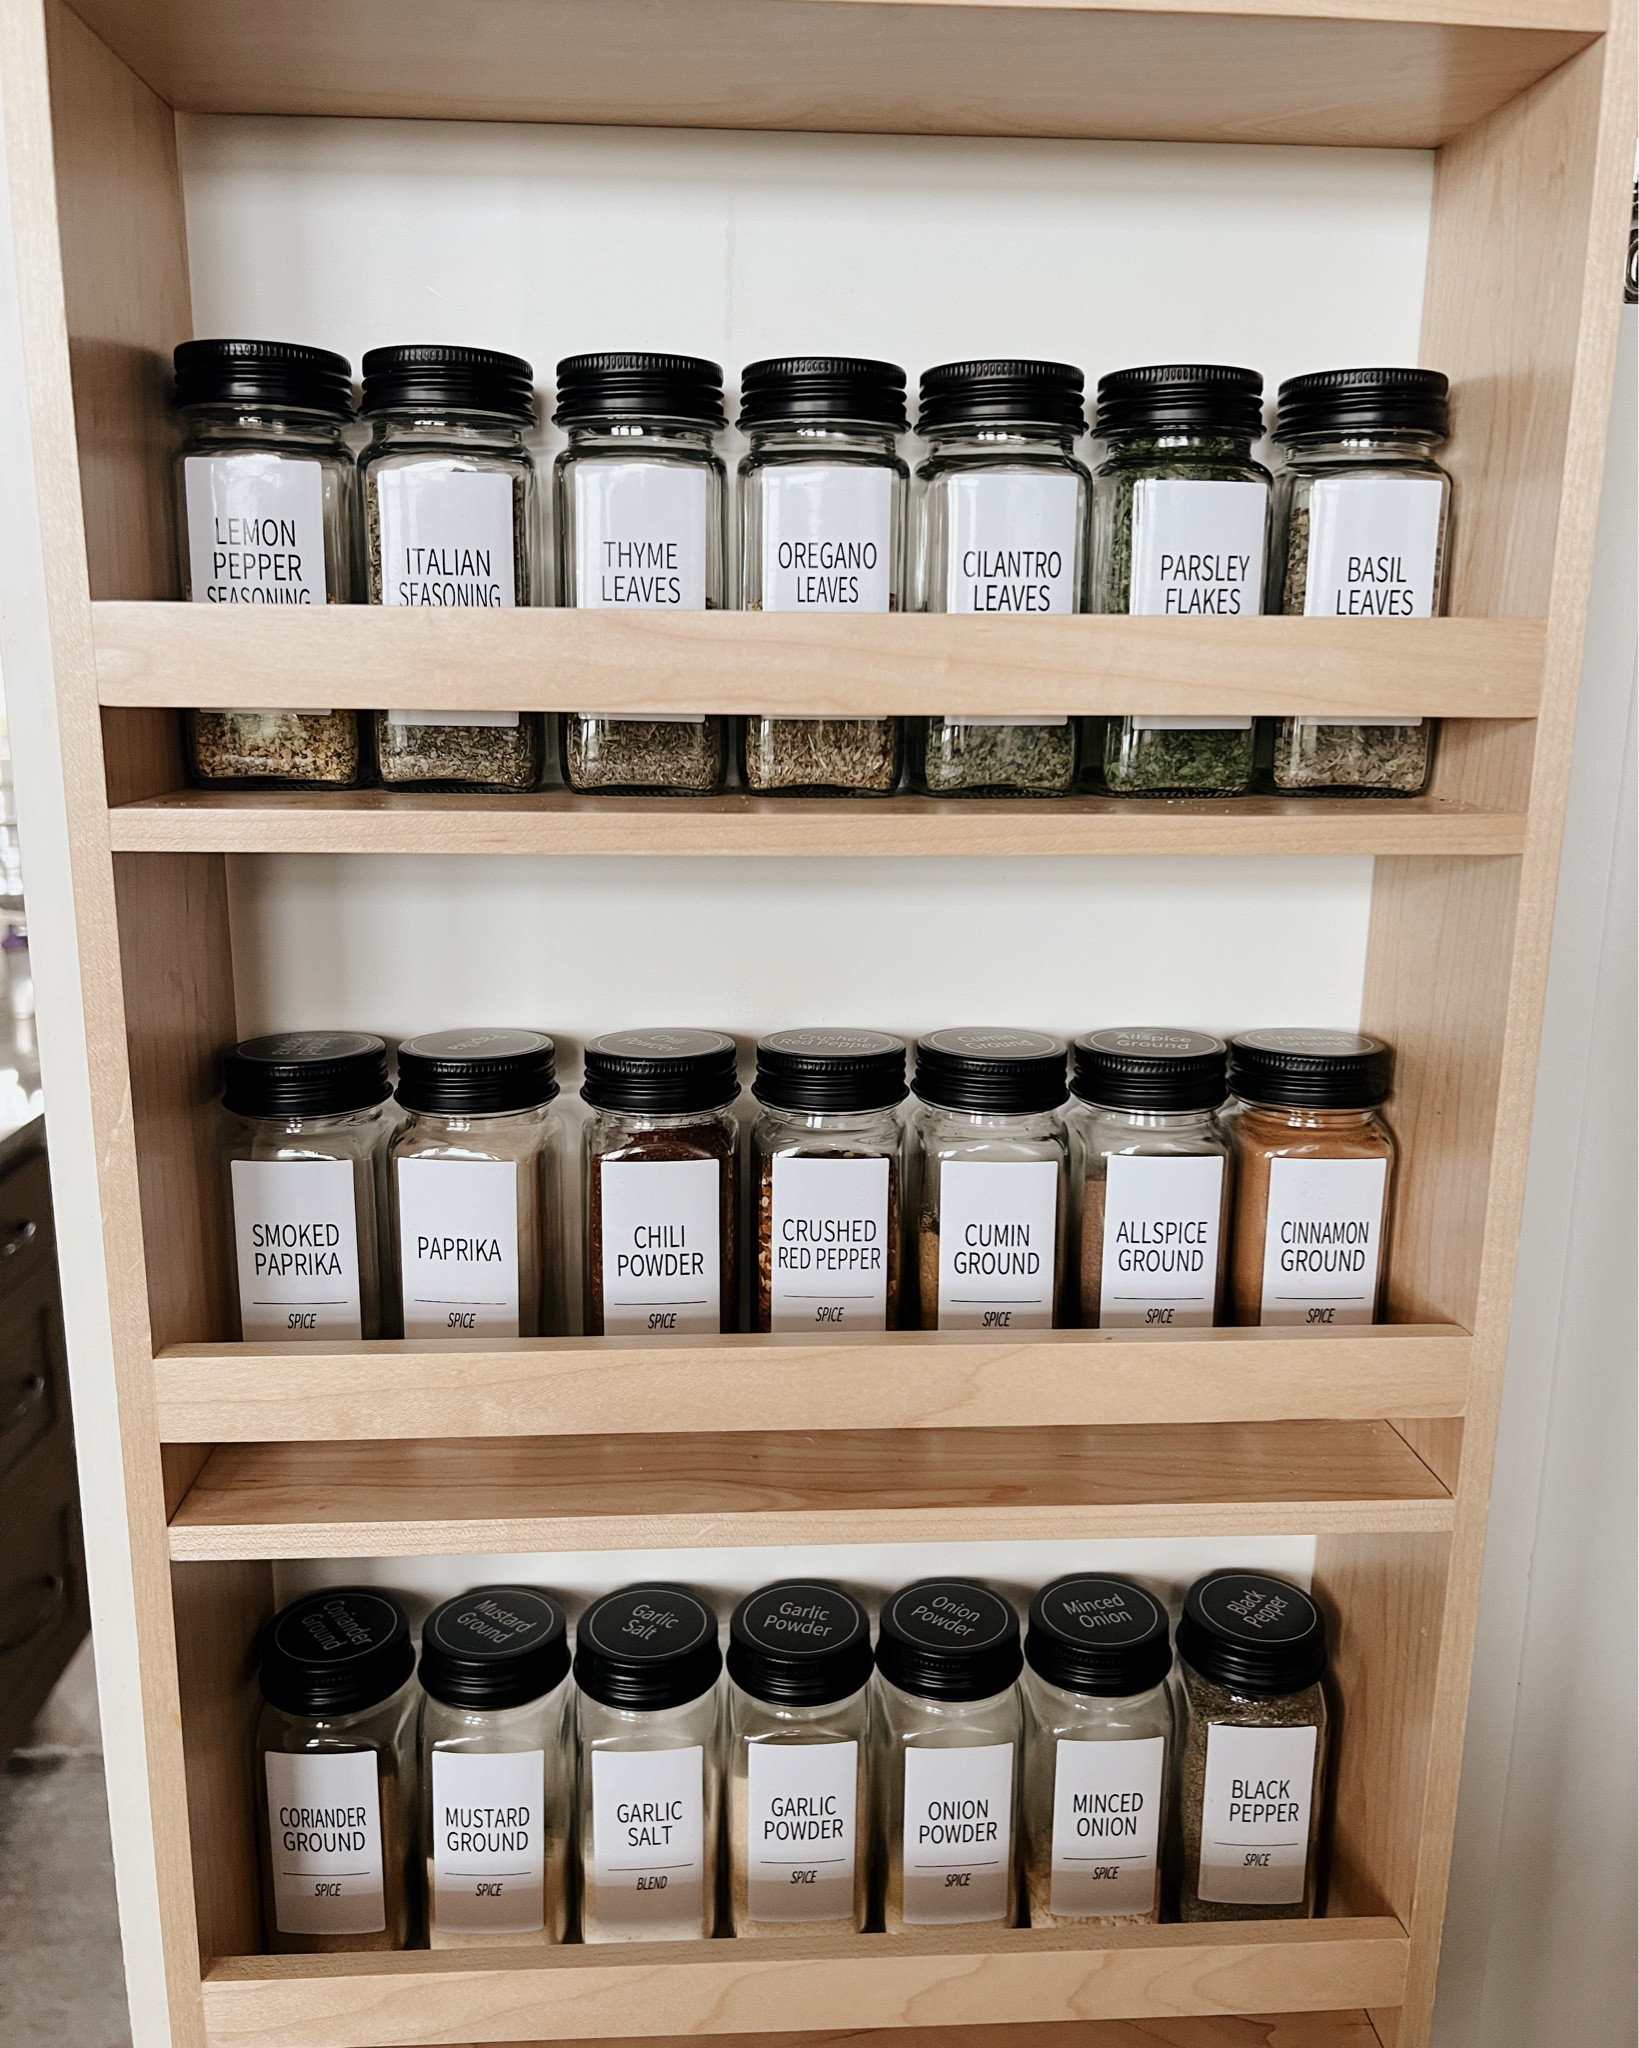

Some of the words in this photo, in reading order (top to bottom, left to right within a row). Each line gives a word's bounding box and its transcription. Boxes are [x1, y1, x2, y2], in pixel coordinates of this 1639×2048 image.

[214, 517, 295, 547] LEMON
[213, 552, 302, 581] PEPPER
[407, 548, 490, 577] ITALIAN
[603, 541, 678, 570] THYME
[779, 542, 877, 569] OREGANO
[963, 551, 1062, 578] CILANTRO
[1161, 555, 1250, 582] PARSLEY
[1348, 556, 1407, 583] BASIL
[602, 575, 680, 604] LEAVES
[797, 576, 858, 603] LEAVES
[974, 584, 1050, 612] LEAVES
[1165, 588, 1242, 615] FLAKES
[1334, 589, 1414, 617] LEAVES
[620, 1038, 681, 1051] Powder
[798, 1034, 870, 1043] Crushed
[817, 1040, 881, 1049] Pepper
[957, 1034, 1017, 1043] Cumin
[965, 1040, 1034, 1050] Ground
[1116, 1040, 1189, 1049] Ground
[1117, 1033, 1192, 1043] Allspice
[1279, 1040, 1350, 1048] Ground
[252, 1223, 338, 1248] SMOKED
[634, 1225, 684, 1249] CHILI
[783, 1219, 876, 1242] CRUSHED
[965, 1224, 1030, 1247] CUMIN
[1116, 1221, 1208, 1244] ALLSPICE
[1281, 1221, 1369, 1244] CINNAMON
[418, 1236, 502, 1262] PAPRIKA
[779, 1246, 811, 1269] RED
[816, 1248, 880, 1270] PEPPER
[254, 1251, 342, 1276] PAPRIKA
[618, 1253, 704, 1279] POWDER
[954, 1251, 1040, 1275] GROUND
[1118, 1249, 1203, 1272] GROUND
[1281, 1249, 1365, 1272] GROUND
[286, 1313, 317, 1330] SPICE
[447, 1312, 476, 1328] SPICE
[647, 1313, 676, 1330] SPICE
[815, 1307, 844, 1323] SPICE
[982, 1311, 1012, 1329] SPICE
[1145, 1309, 1175, 1324] SPICE
[1306, 1308, 1336, 1324] SPICE
[778, 1600, 831, 1622] Garlic
[930, 1595, 981, 1622] Onion
[1062, 1592, 1125, 1614] Minced
[1224, 1589, 1268, 1617] Black
[1244, 1595, 1290, 1630] Pepper
[323, 1600, 373, 1645] Coriander
[475, 1598, 538, 1634] Mustard
[630, 1603, 680, 1629] Garlic
[763, 1613, 834, 1638] Powder
[909, 1604, 976, 1639] Powder
[1078, 1607, 1133, 1628] Onion
[301, 1613, 348, 1651] Ground
[456, 1611, 509, 1645] Ground
[621, 1617, 659, 1641] Salt
[1232, 1779, 1290, 1799] BLACK
[617, 1801, 682, 1823] GARLIC
[771, 1796, 836, 1817] GARLIC
[928, 1799, 988, 1821] ONION
[1073, 1793, 1143, 1813] MINCED
[1229, 1803, 1299, 1823] PEPPER
[280, 1807, 366, 1829] CORIANDER
[446, 1807, 530, 1828] MUSTARD
[1077, 1816, 1137, 1839] ONION
[626, 1825, 673, 1847] SALT
[764, 1819, 843, 1840] POWDER
[919, 1822, 997, 1844] POWDER
[283, 1831, 365, 1852] GROUND
[447, 1831, 528, 1852] GROUND
[1243, 1853, 1271, 1869] SPICE
[636, 1876, 667, 1891] BLEND
[790, 1870, 818, 1887] SPICE
[944, 1873, 972, 1887] SPICE
[1092, 1866, 1120, 1880] SPICE
[314, 1883, 341, 1898] SPICE
[475, 1883, 503, 1896] SPICE
